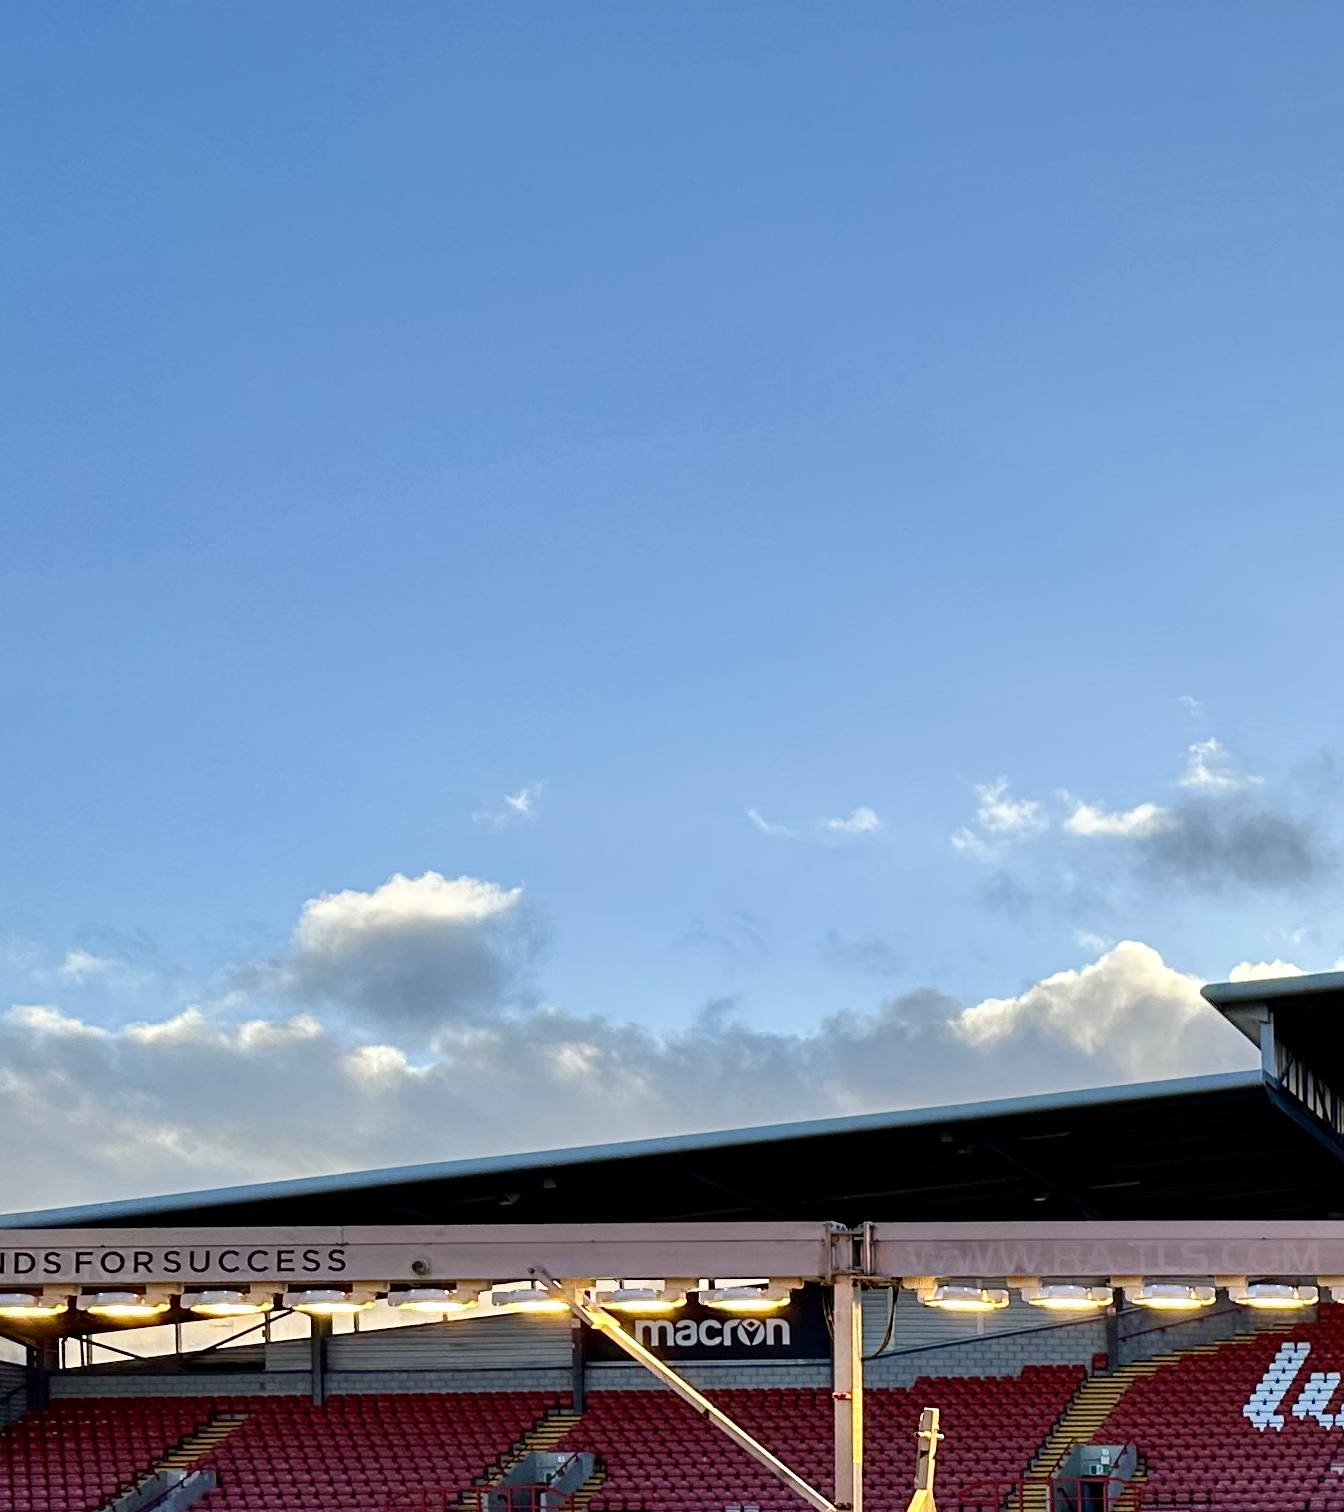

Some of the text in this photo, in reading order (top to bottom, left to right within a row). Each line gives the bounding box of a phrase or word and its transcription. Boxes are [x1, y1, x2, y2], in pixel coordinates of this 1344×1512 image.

[0, 1250, 346, 1274] DS FOR SUCCESS
[634, 1318, 790, 1347] macron
